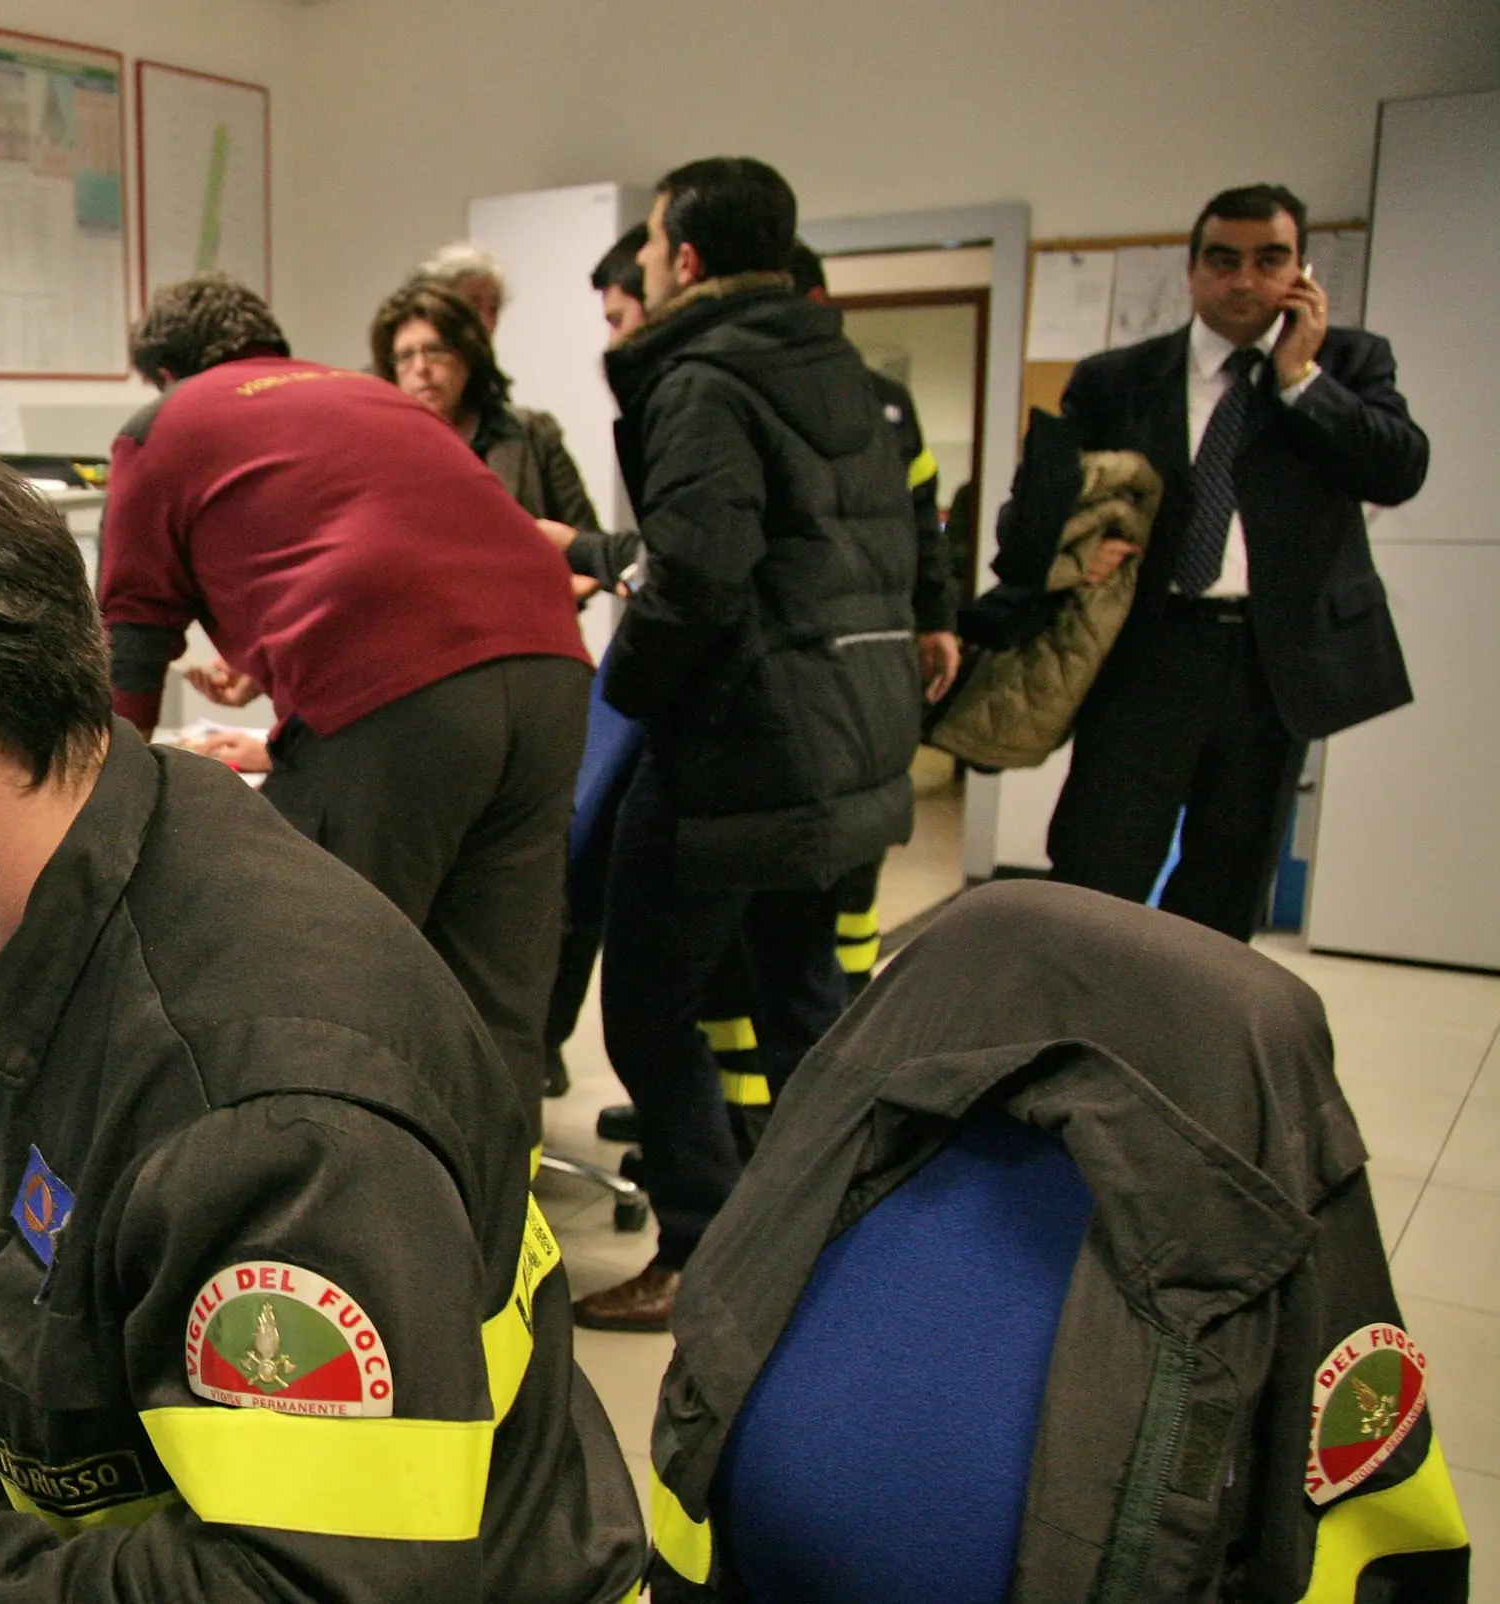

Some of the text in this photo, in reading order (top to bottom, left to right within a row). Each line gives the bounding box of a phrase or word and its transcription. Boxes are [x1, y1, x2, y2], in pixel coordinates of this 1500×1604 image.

[187, 1267, 390, 1400] VIGILI DEL FUOCO
[1318, 1345, 1360, 1388] DEL
[1370, 1328, 1426, 1369] FUOCO
[252, 1397, 347, 1415] PERMANENTE
